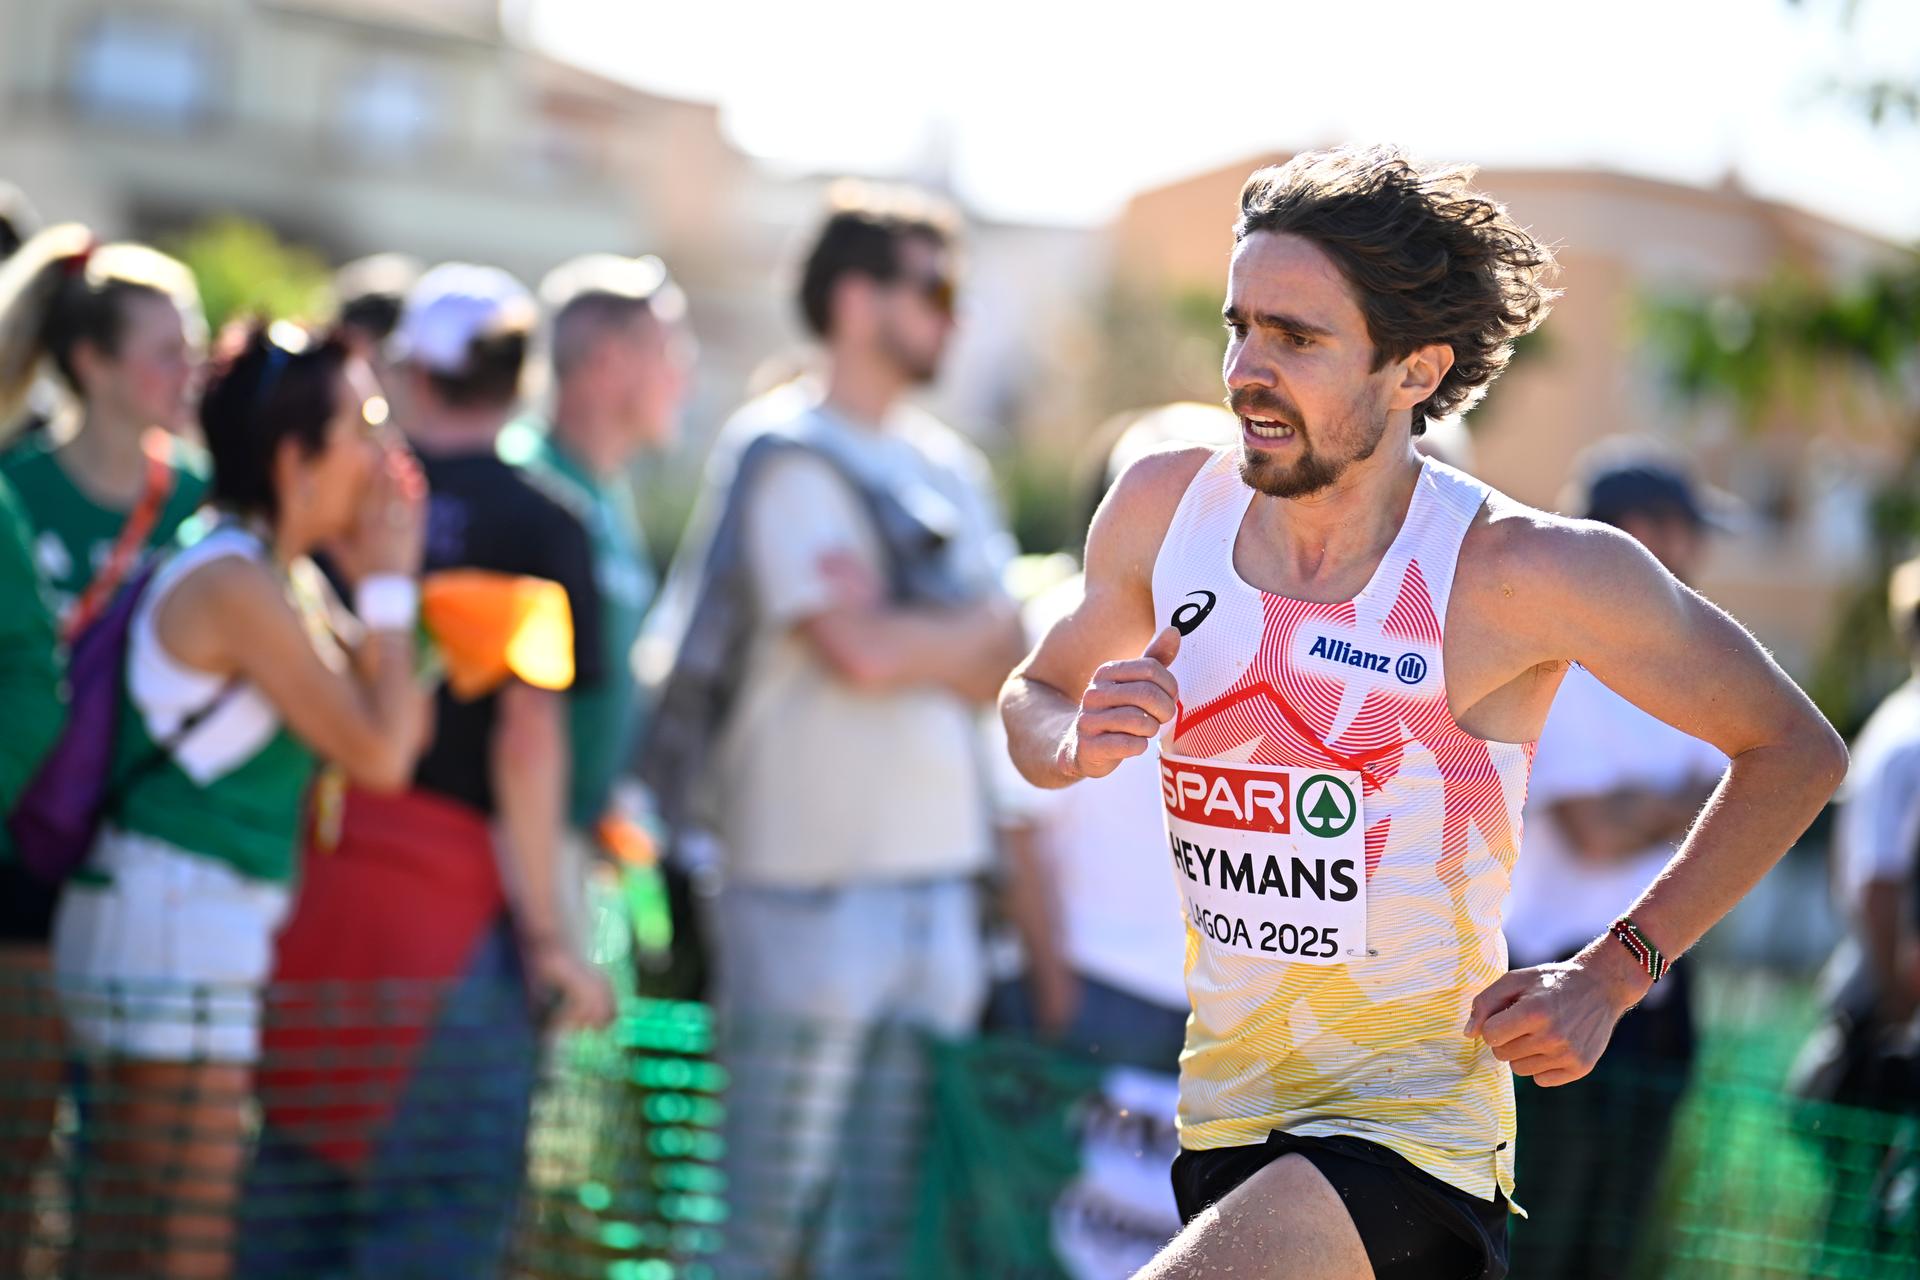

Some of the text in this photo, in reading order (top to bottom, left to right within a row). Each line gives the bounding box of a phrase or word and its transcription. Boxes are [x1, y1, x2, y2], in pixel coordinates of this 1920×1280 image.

[1309, 635, 1390, 673] Allianz
[1161, 767, 1285, 824] SPAR
[1170, 832, 1359, 902] HEYMANS
[1189, 897, 1339, 958] LAGOA 2025
